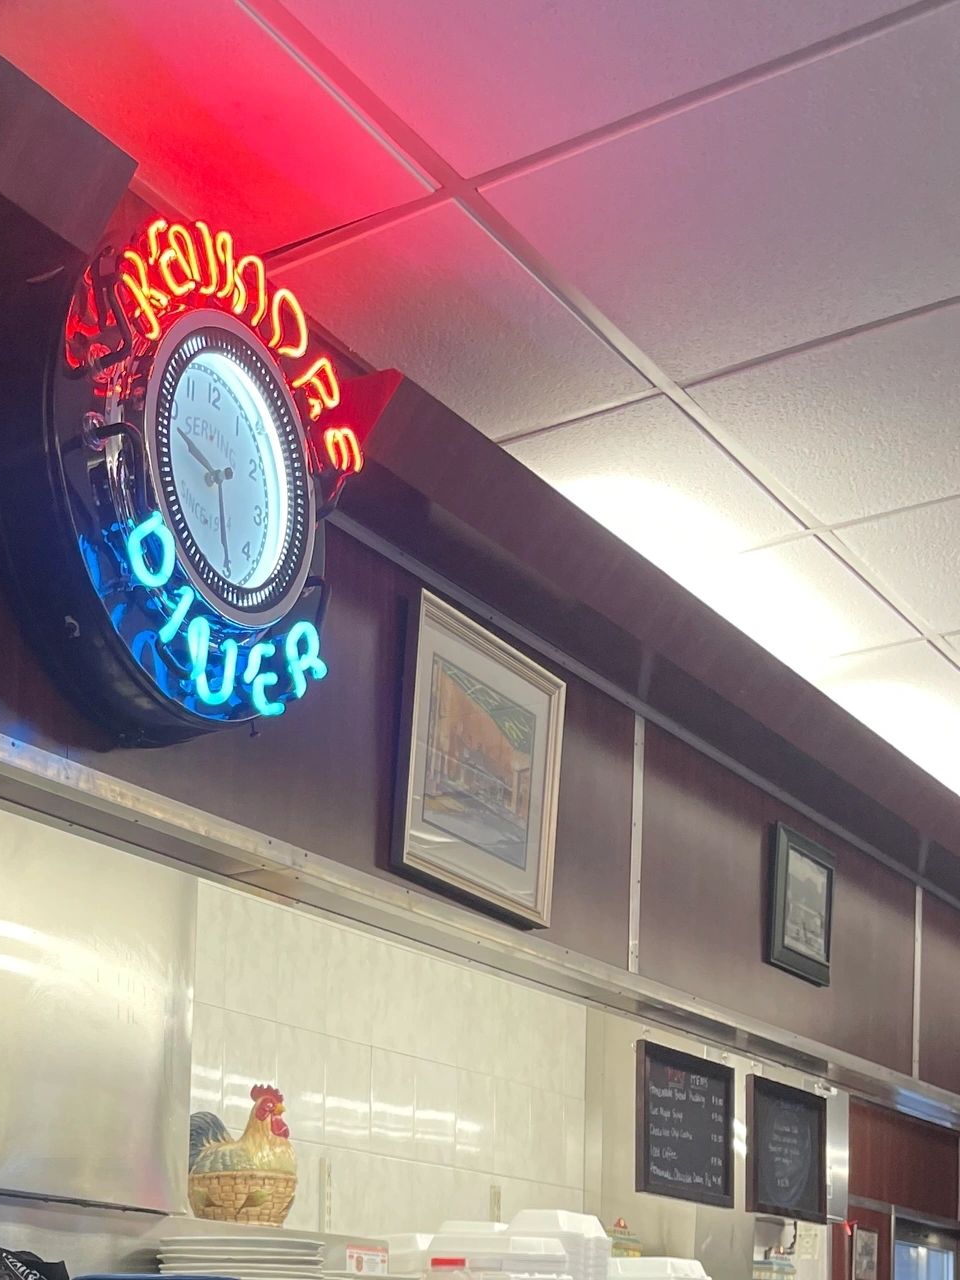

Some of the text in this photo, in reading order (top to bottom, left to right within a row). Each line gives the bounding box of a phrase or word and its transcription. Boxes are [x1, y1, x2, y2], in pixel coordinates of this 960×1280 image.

[120, 219, 363, 473] KENMORE
[186, 376, 195, 402] 11
[208, 381, 222, 410] 12
[185, 416, 237, 469] SERVING
[249, 459, 258, 481] 2
[206, 515, 232, 533] 194
[253, 504, 263, 527] 3
[241, 540, 252, 562] 4
[128, 511, 328, 716] DINER
